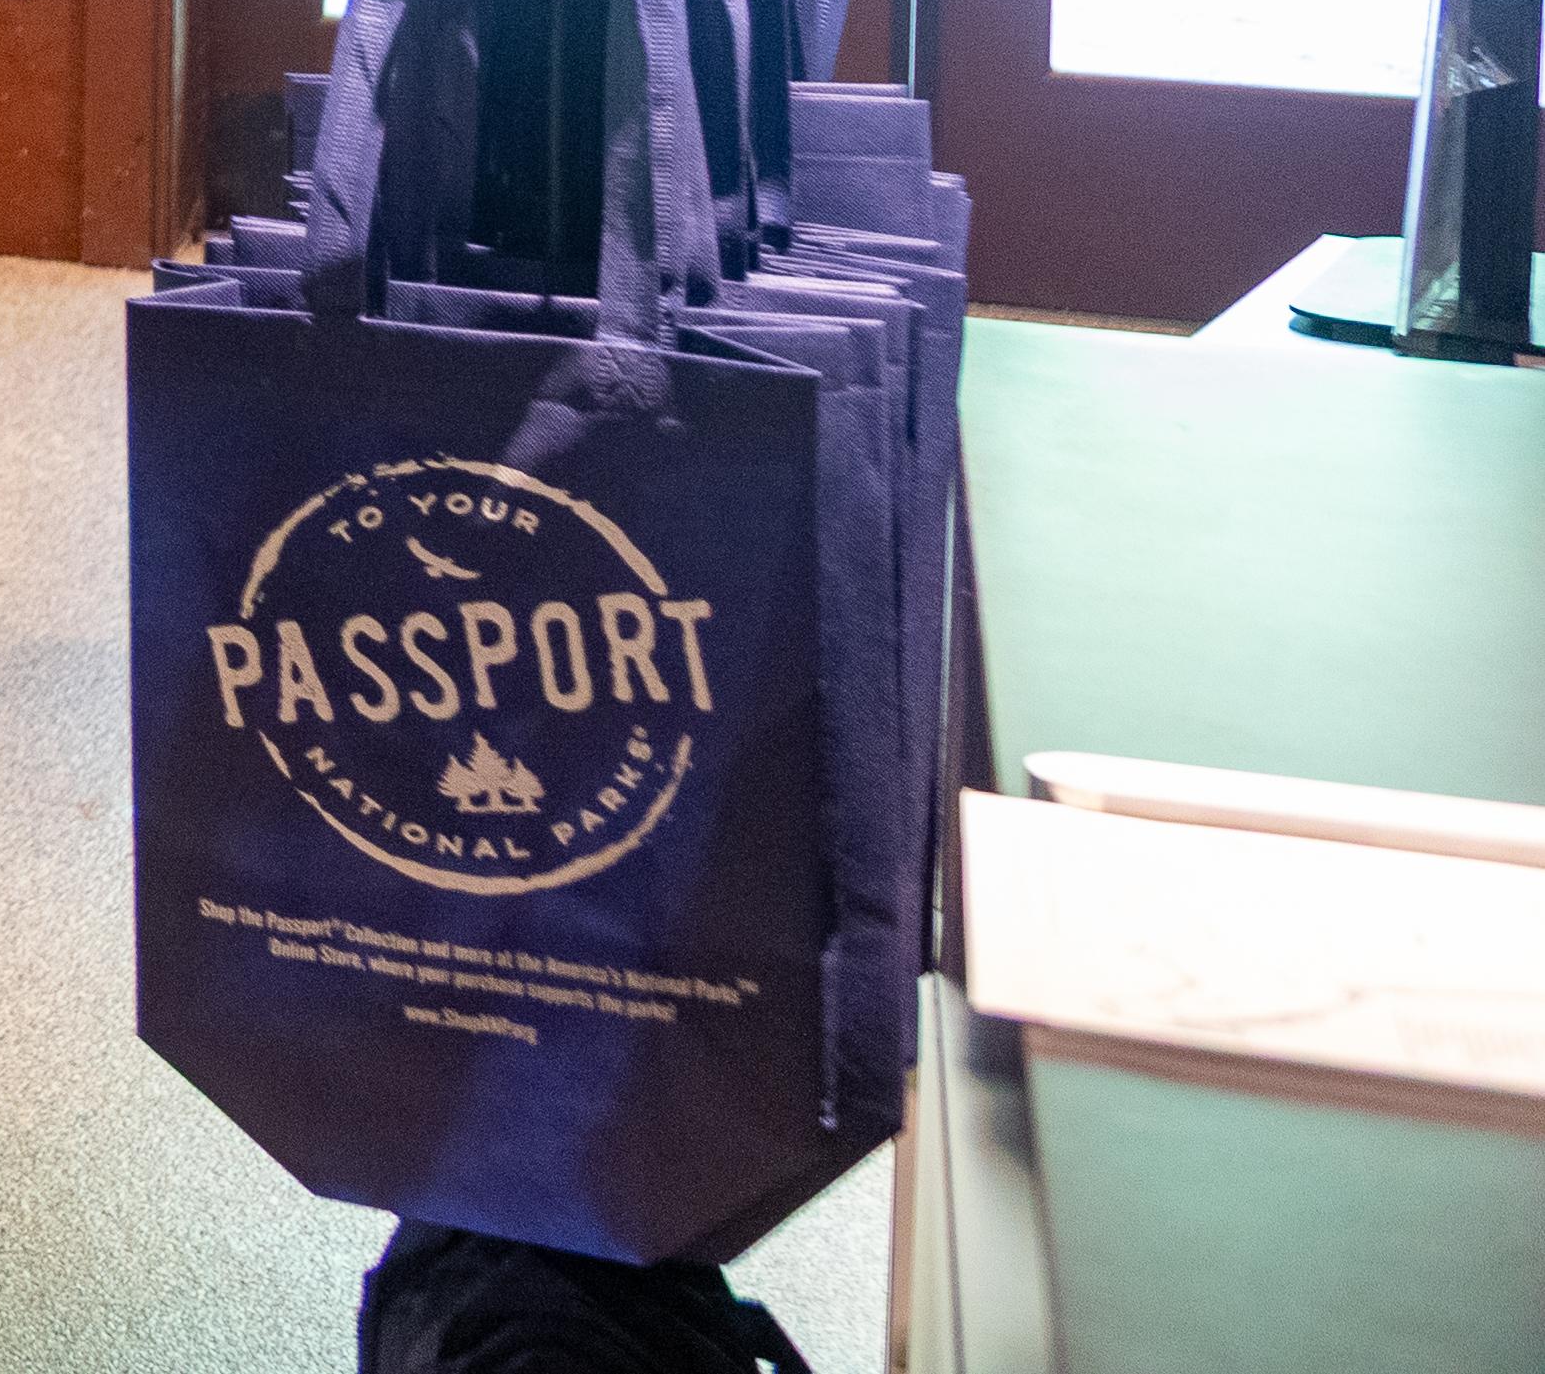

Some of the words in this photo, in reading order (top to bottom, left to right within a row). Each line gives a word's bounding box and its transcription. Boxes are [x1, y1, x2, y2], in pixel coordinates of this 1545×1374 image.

[329, 504, 383, 545] TO
[409, 492, 541, 537] YOUR
[206, 590, 714, 729] PASSPORT
[305, 745, 531, 861] NATIONAL
[199, 898, 236, 925] Shop
[238, 906, 264, 928] the
[345, 921, 419, 954] Collection
[421, 938, 451, 959] and
[453, 944, 493, 965] more
[497, 950, 514, 969] at
[517, 951, 542, 973] the
[546, 956, 623, 988] America's
[271, 937, 317, 961] Online
[319, 944, 365, 971] Store,
[368, 956, 415, 979] where
[417, 964, 450, 987] your
[452, 967, 525, 997] purchase
[528, 981, 595, 1010] supports
[597, 991, 625, 1015] the
